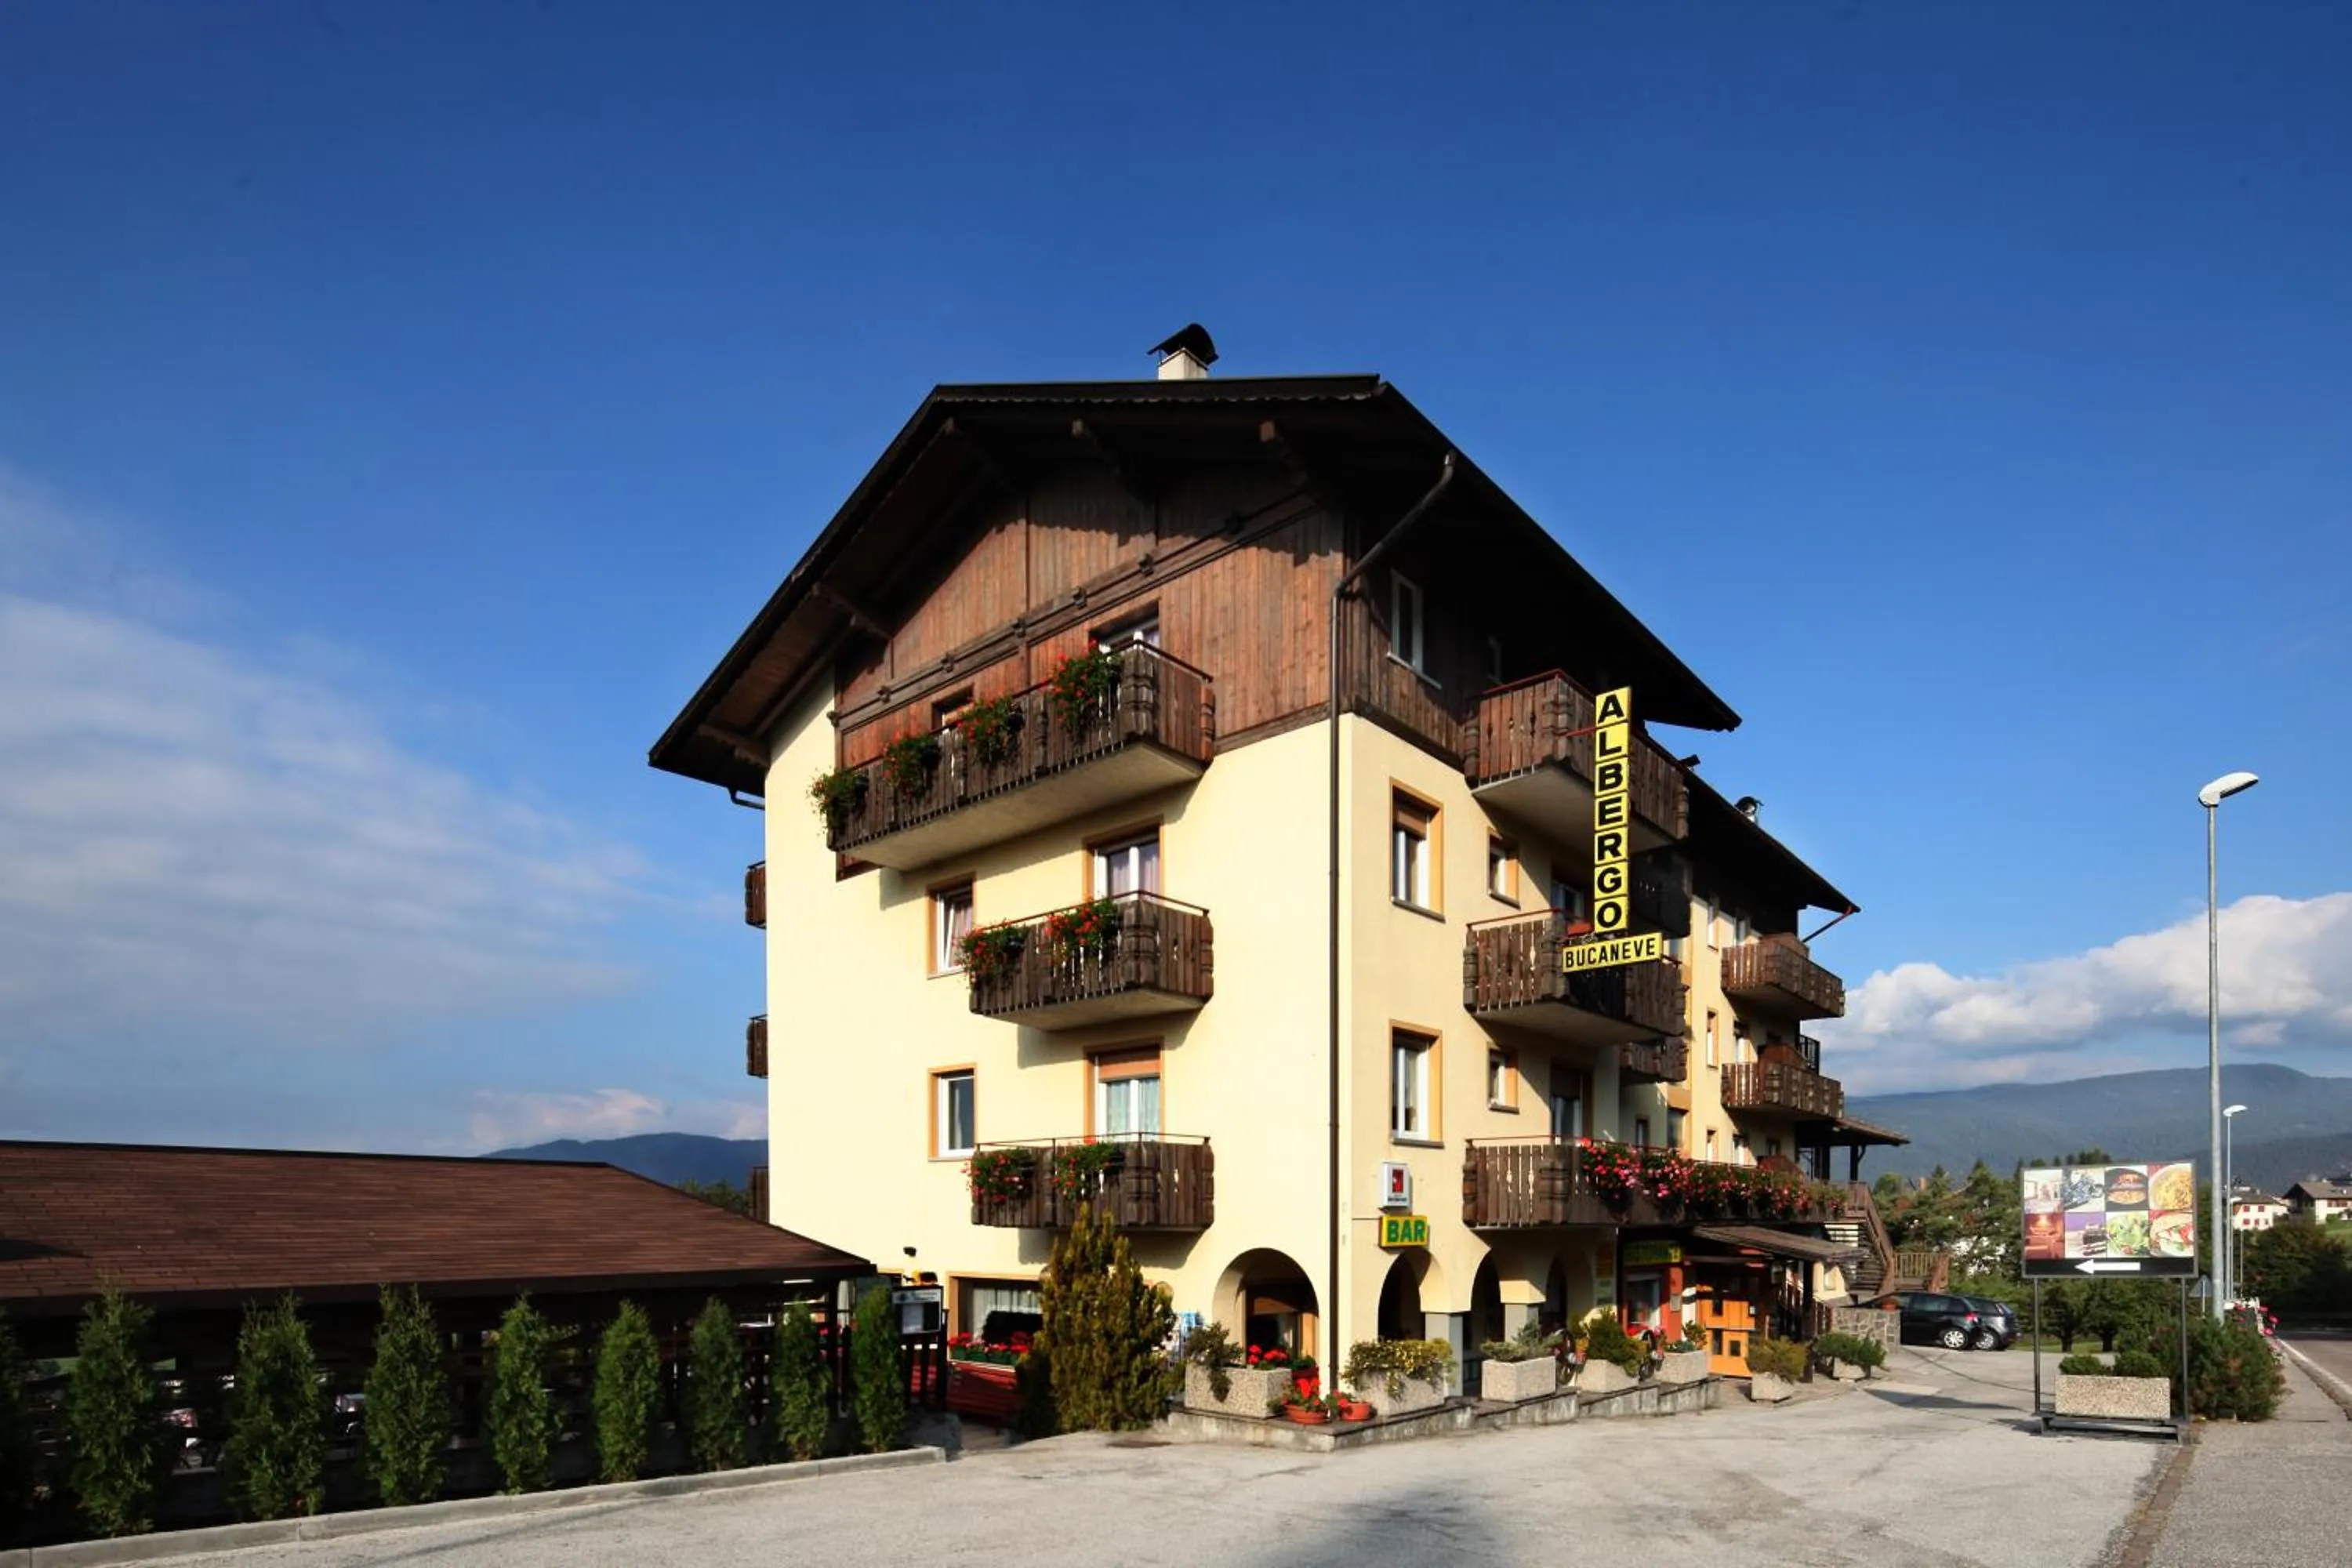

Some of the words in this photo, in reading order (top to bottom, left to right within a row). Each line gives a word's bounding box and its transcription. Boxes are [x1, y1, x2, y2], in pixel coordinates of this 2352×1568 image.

[1597, 694, 1625, 928] ALBERGO
[1566, 938, 1656, 968] BUCANEVE
[1387, 1219, 1426, 1243] BAR
